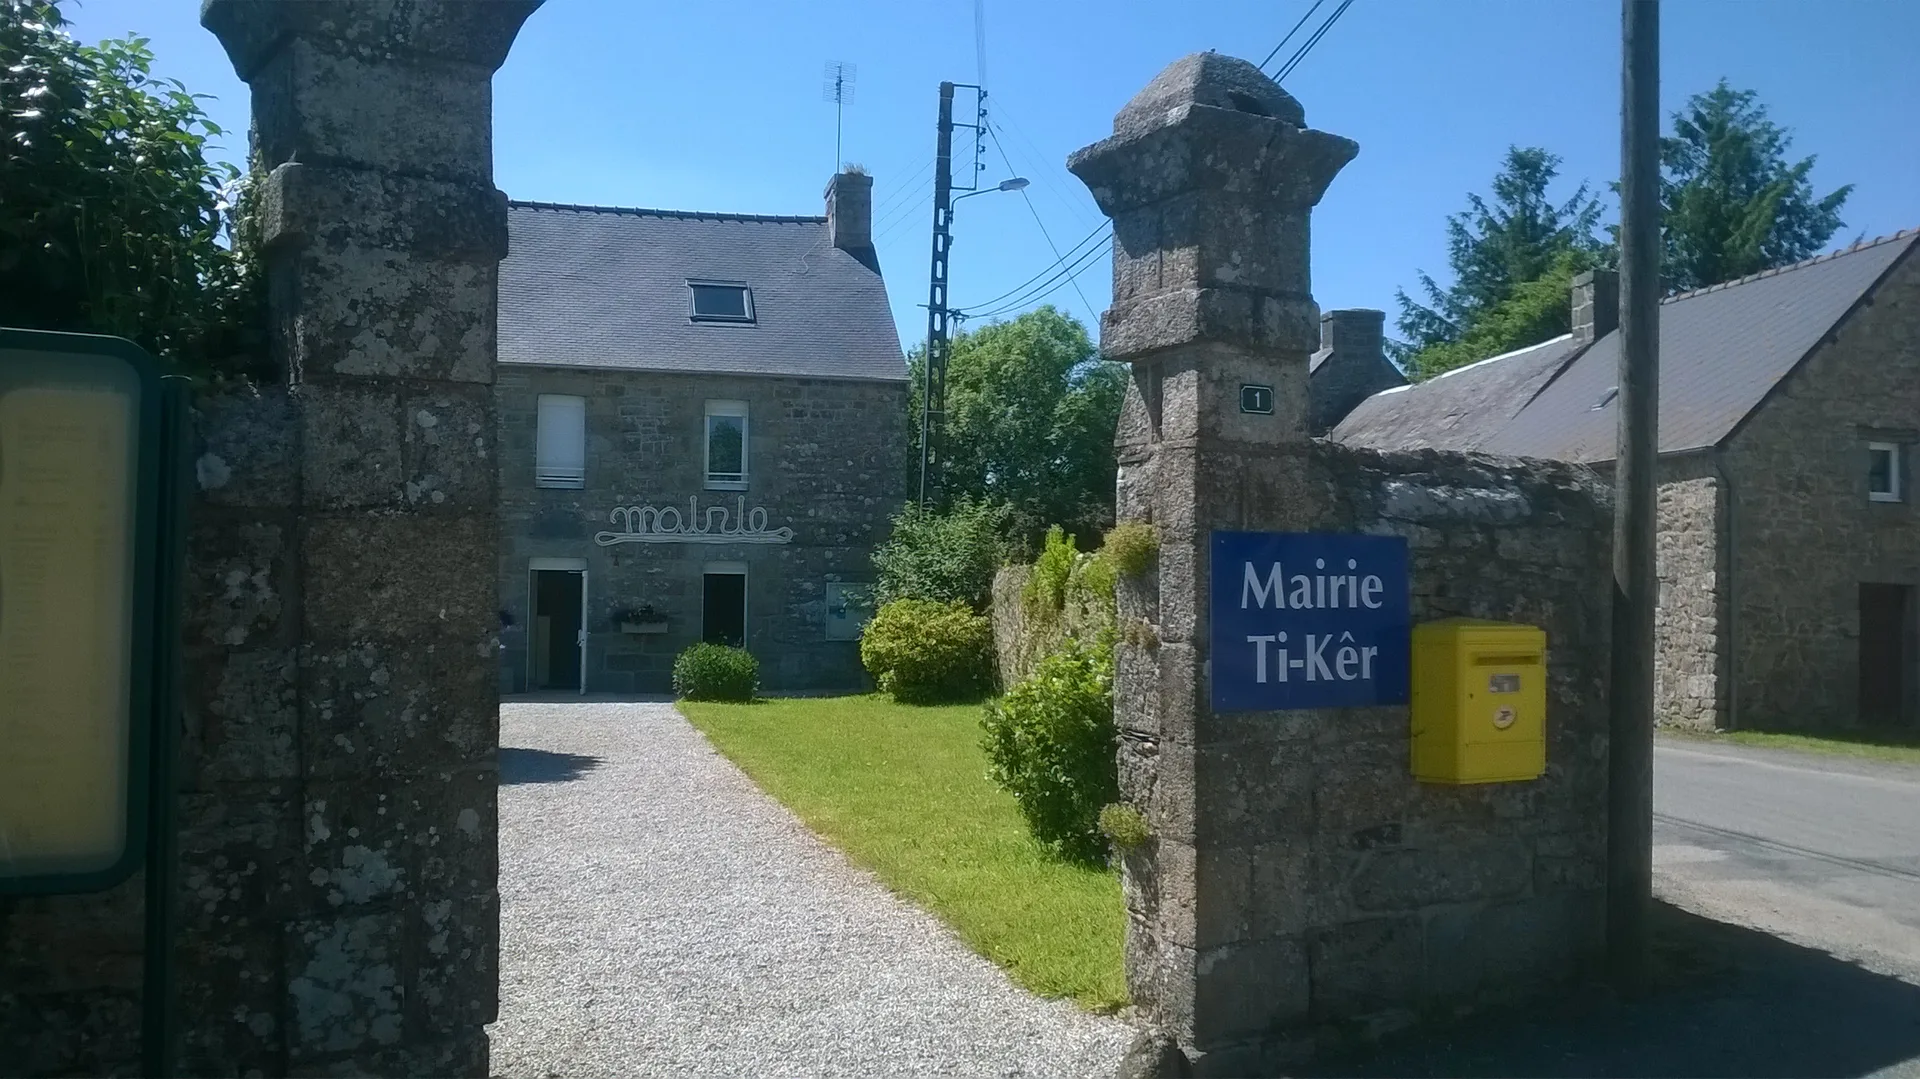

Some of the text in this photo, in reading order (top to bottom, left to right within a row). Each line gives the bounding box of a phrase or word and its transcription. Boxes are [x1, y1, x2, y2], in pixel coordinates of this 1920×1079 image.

[1254, 391, 1261, 408] 1
[1241, 558, 1384, 609] Mairie
[1247, 631, 1378, 683] Ti-Kêr
